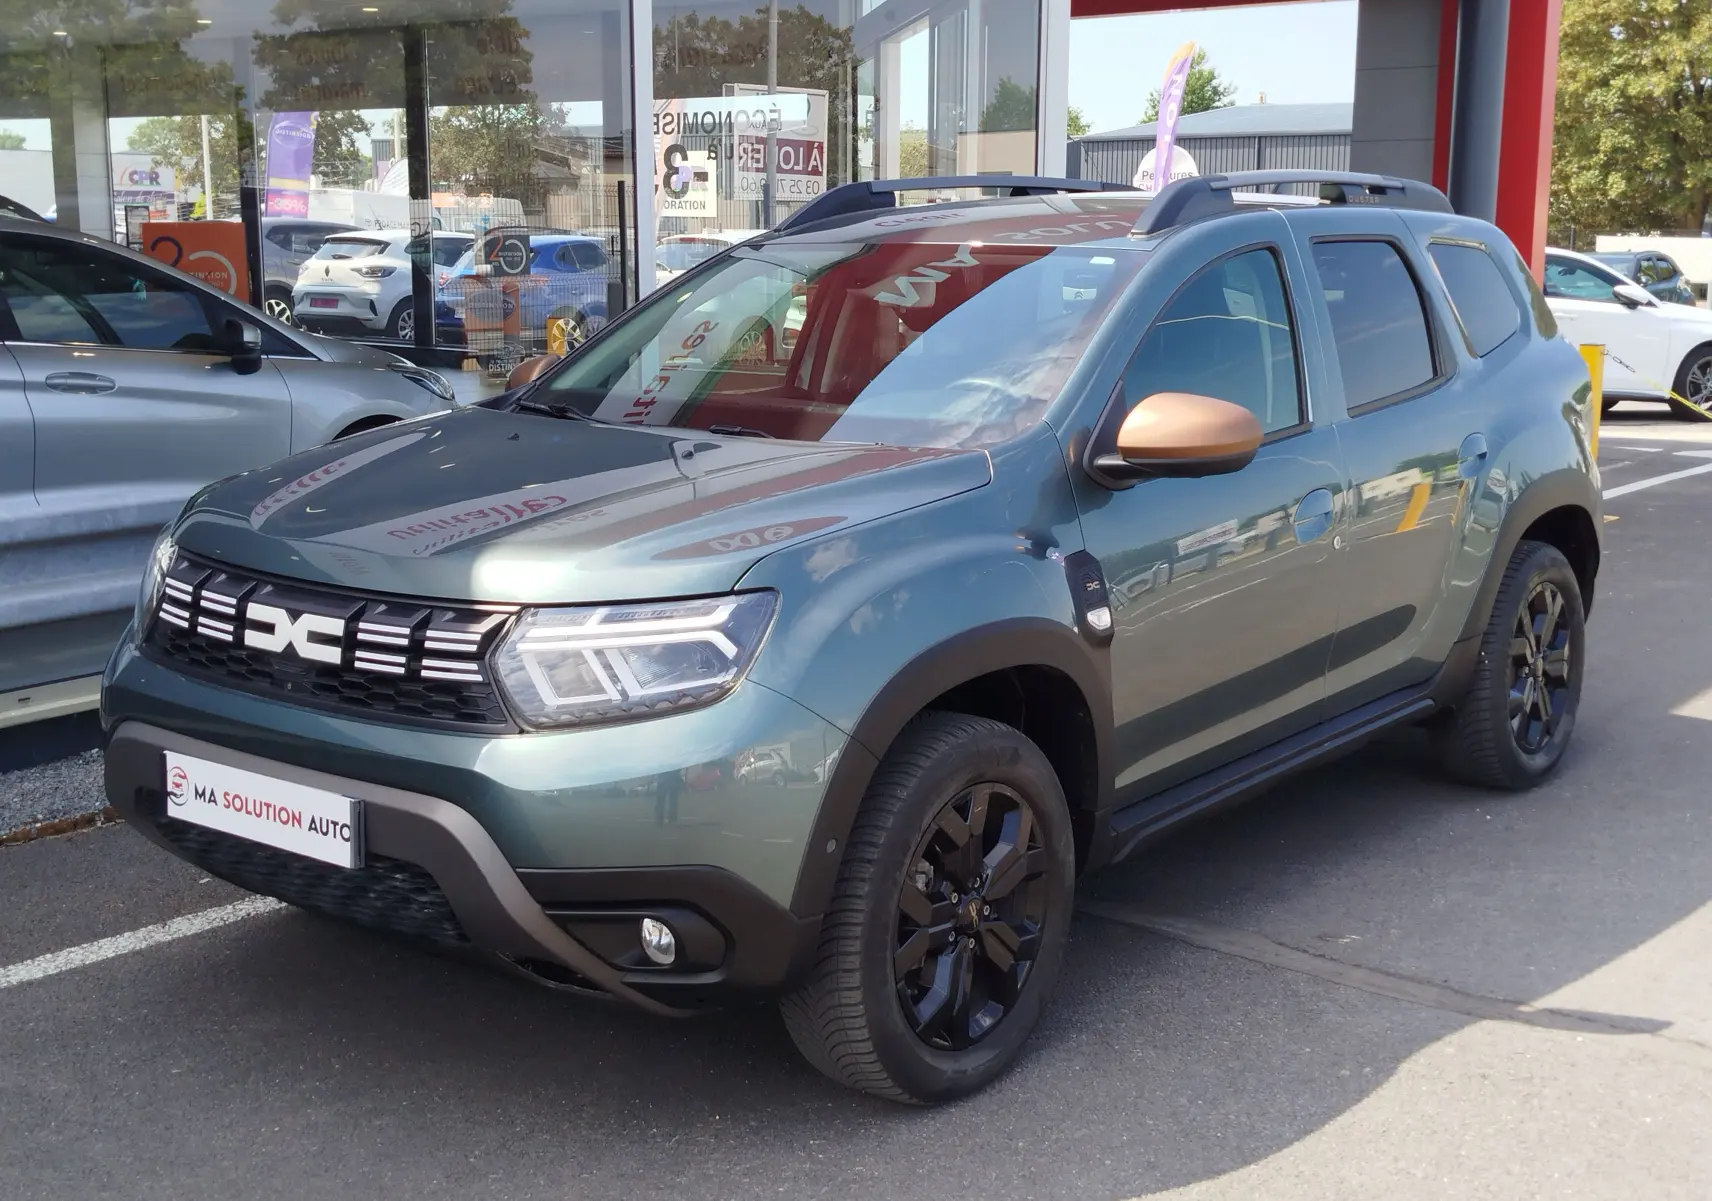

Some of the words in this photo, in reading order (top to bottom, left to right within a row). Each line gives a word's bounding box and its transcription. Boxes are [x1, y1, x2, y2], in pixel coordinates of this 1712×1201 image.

[128, 169, 161, 186] CPR
[1142, 170, 1194, 181] Peures
[194, 782, 218, 807] MA
[223, 791, 302, 829] SOLUTION
[308, 814, 352, 843] AUTO
